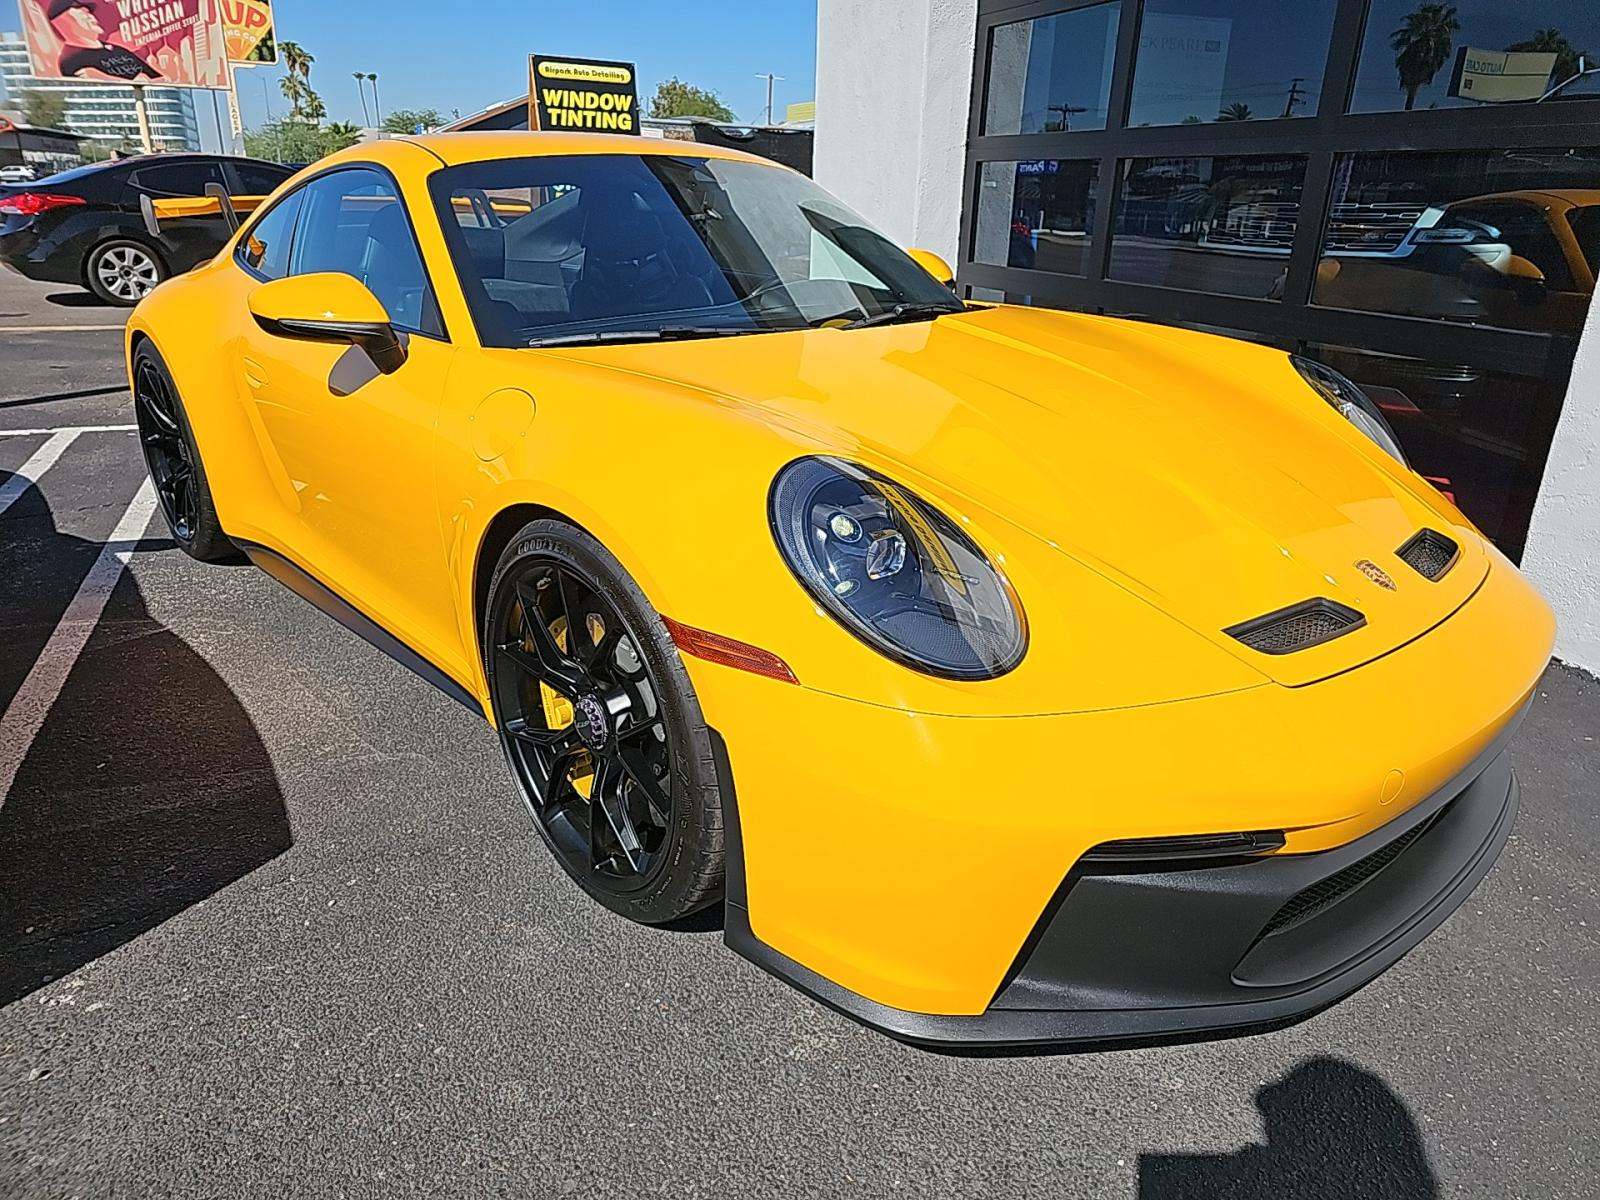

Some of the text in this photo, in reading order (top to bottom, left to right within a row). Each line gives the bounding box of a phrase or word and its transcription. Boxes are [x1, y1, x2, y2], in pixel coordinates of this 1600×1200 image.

[119, 1, 184, 43] RUSSIAN
[221, 0, 267, 29] UP
[162, 21, 181, 36] COFFEE
[545, 66, 625, 81] Airpark Auto Detailing
[543, 89, 632, 111] WINDOW
[547, 108, 632, 131] TINTING
